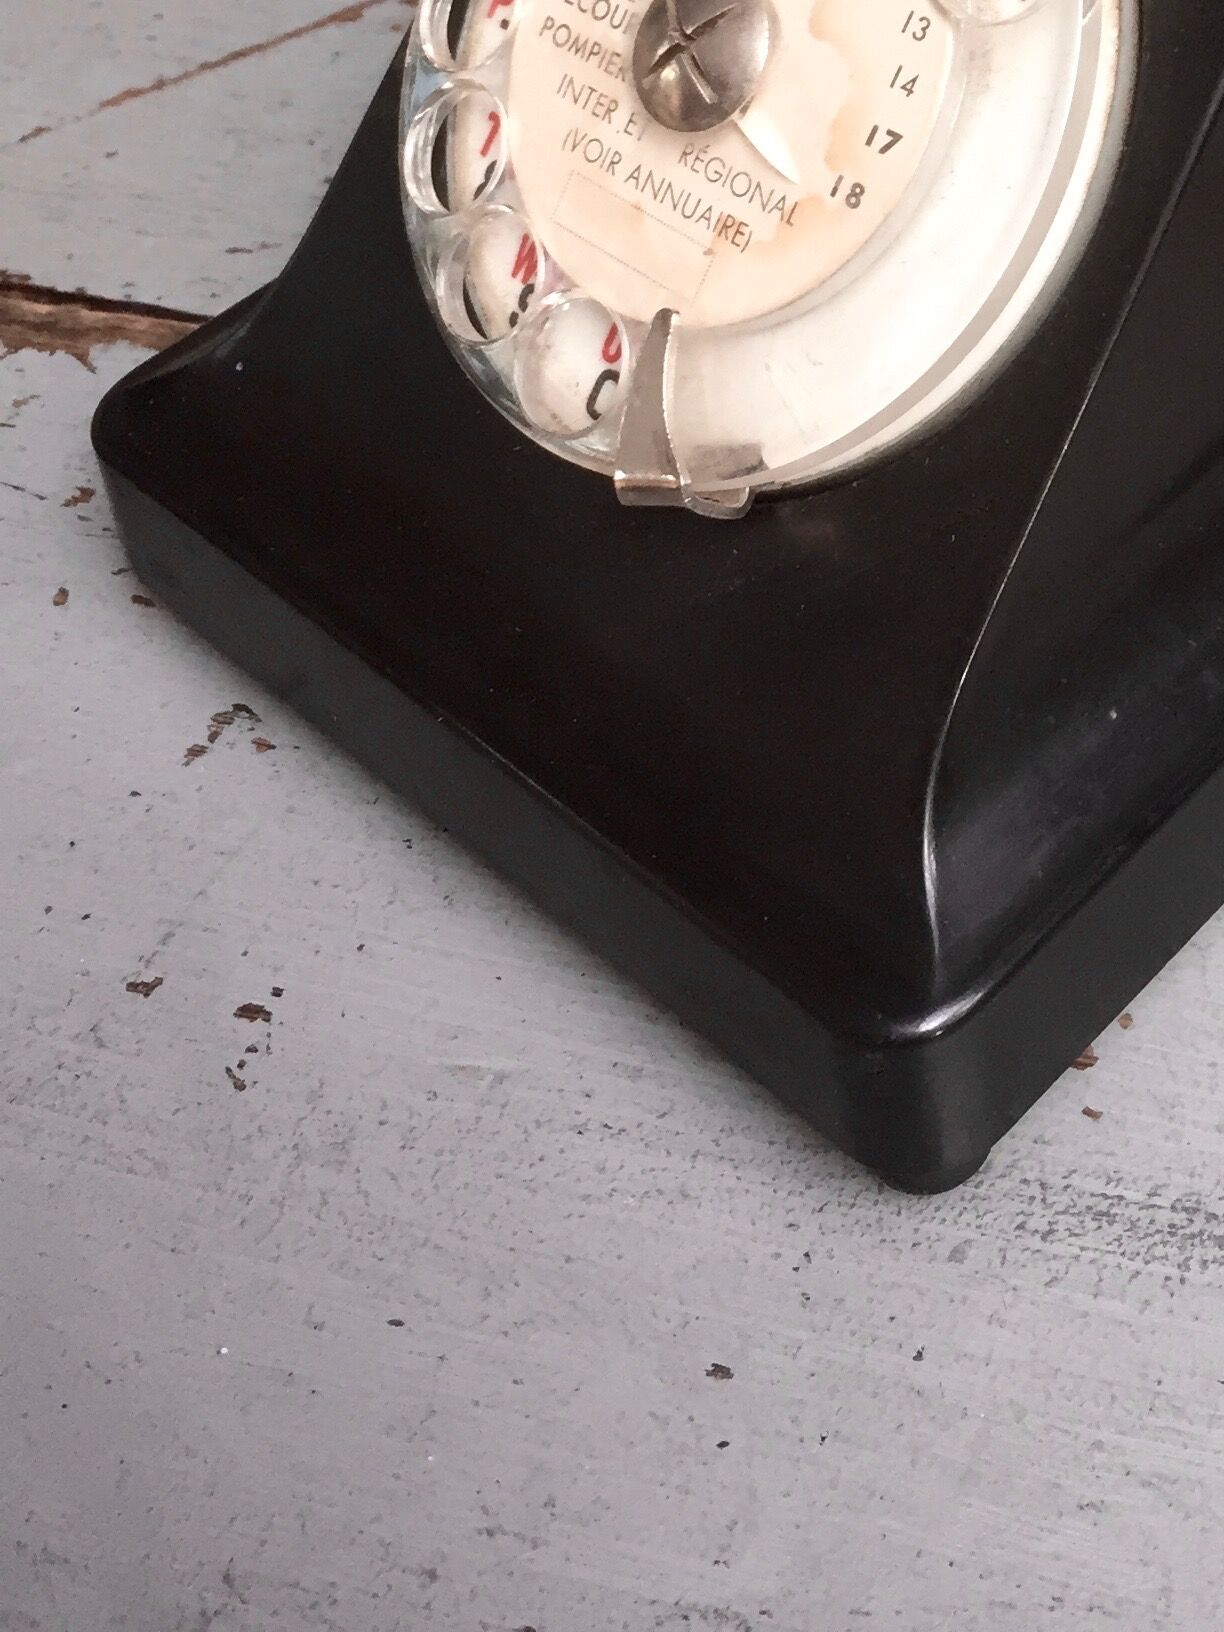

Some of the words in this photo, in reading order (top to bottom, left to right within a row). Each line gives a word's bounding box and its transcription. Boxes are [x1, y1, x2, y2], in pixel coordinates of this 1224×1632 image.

[901, 10, 932, 42] 13
[889, 64, 920, 97] 14
[864, 124, 905, 155] 17
[677, 143, 799, 228] RÉGIONAL
[829, 174, 867, 210] 18
[623, 163, 753, 254] ANNUAIRE)
